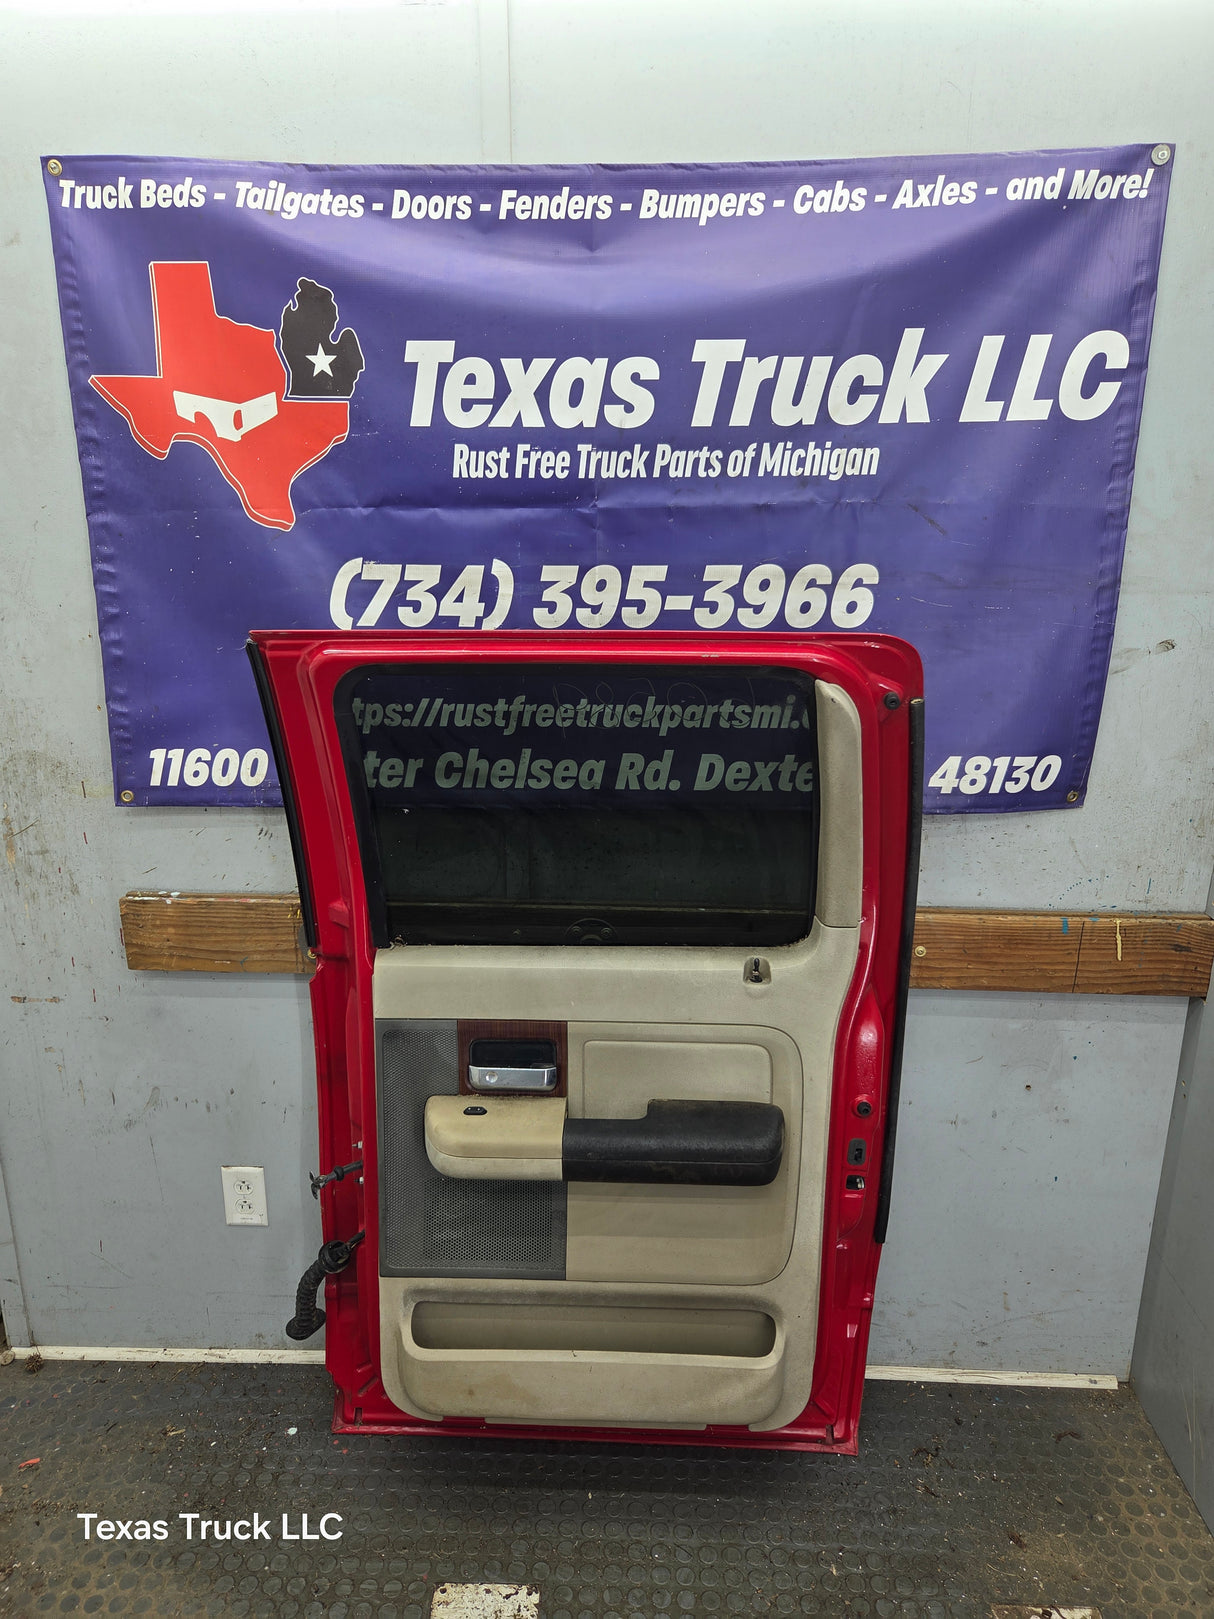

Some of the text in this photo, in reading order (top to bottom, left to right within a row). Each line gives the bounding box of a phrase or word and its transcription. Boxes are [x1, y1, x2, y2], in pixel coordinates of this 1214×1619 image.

[60, 177, 133, 209] Truck
[141, 177, 206, 208] Beds
[236, 180, 364, 219] Tailgates
[392, 190, 472, 219] Doors
[499, 187, 612, 219] Fenders
[639, 189, 765, 225] Bumpers
[794, 180, 867, 214] Cabs
[875, 194, 887, 202] -
[892, 175, 977, 209] Axles
[1006, 168, 1065, 200] and
[1068, 169, 1154, 199] More!
[405, 328, 1129, 428] Texas Truck LLC
[453, 442, 879, 480] Rust Free Truck Parts of Michigan
[330, 558, 878, 630] (734) 395-3966
[150, 749, 1061, 794] 11600 ter Chelsea Rd. Dexte 48130
